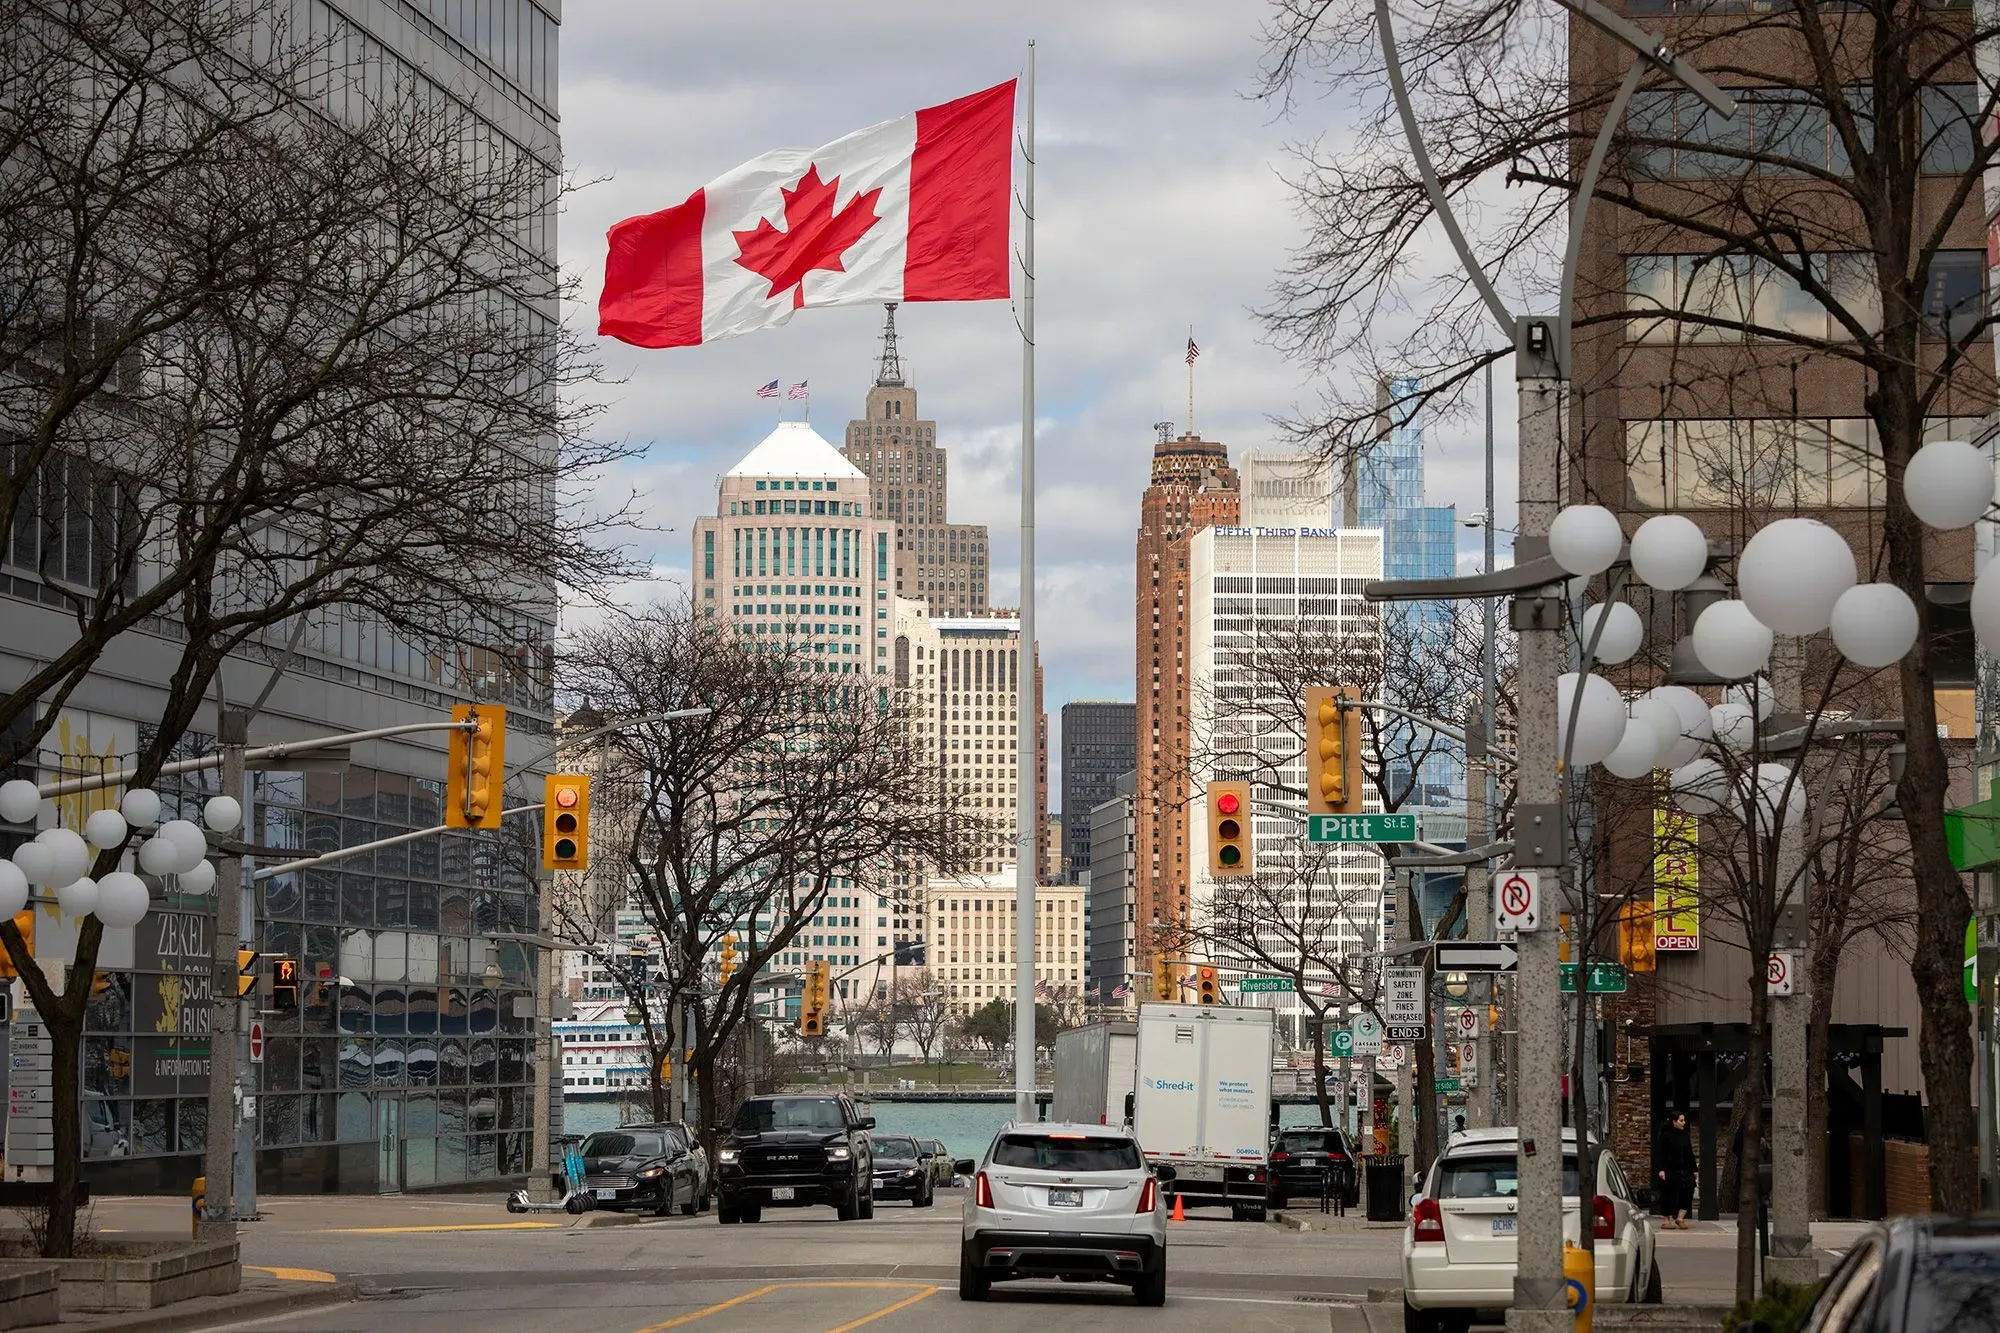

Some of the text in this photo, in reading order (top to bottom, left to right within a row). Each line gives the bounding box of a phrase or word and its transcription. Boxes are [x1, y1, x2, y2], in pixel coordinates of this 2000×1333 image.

[1215, 526, 1337, 537] FIFTH THIRD BANK
[1321, 817, 1372, 839] Pitt
[1665, 842, 1688, 932] RILL
[157, 913, 212, 957] ZEKEL
[1657, 937, 1697, 948] OPEN
[1388, 970, 1422, 978] COMMUNITY
[1242, 980, 1291, 990] Riverside Dr.
[1397, 991, 1413, 999] ZONE
[1388, 1013, 1422, 1021] INCREASED
[1391, 1028, 1420, 1038] ENDS
[161, 1059, 201, 1076] INFORMATION
[1156, 1080, 1194, 1091] Shred-it
